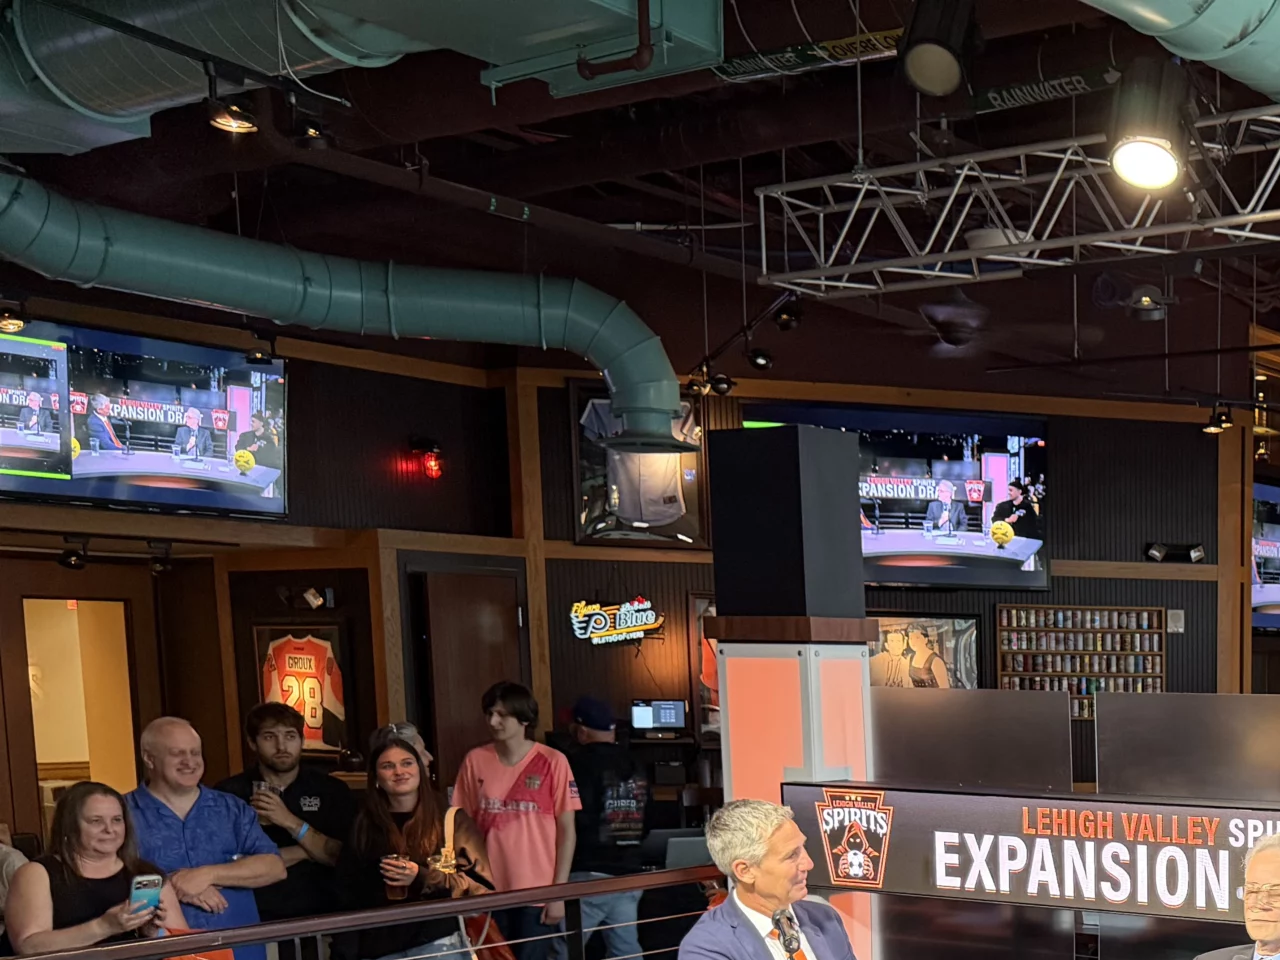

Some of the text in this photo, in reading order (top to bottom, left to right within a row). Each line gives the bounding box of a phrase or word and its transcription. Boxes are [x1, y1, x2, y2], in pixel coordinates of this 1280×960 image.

[725, 52, 803, 75] RAINWATER
[987, 75, 1092, 109] RAINWATER
[108, 403, 165, 422] XPANSION
[615, 609, 656, 630] Blue
[287, 655, 314, 671] GIROUX
[281, 674, 324, 729] 28
[832, 799, 877, 809] LEHIGH VALLEY
[822, 807, 889, 838] SPIRITS
[1021, 806, 1114, 839] LEHIGH
[1122, 811, 1221, 847] VALLEY
[932, 830, 1230, 912] EXPANSION
